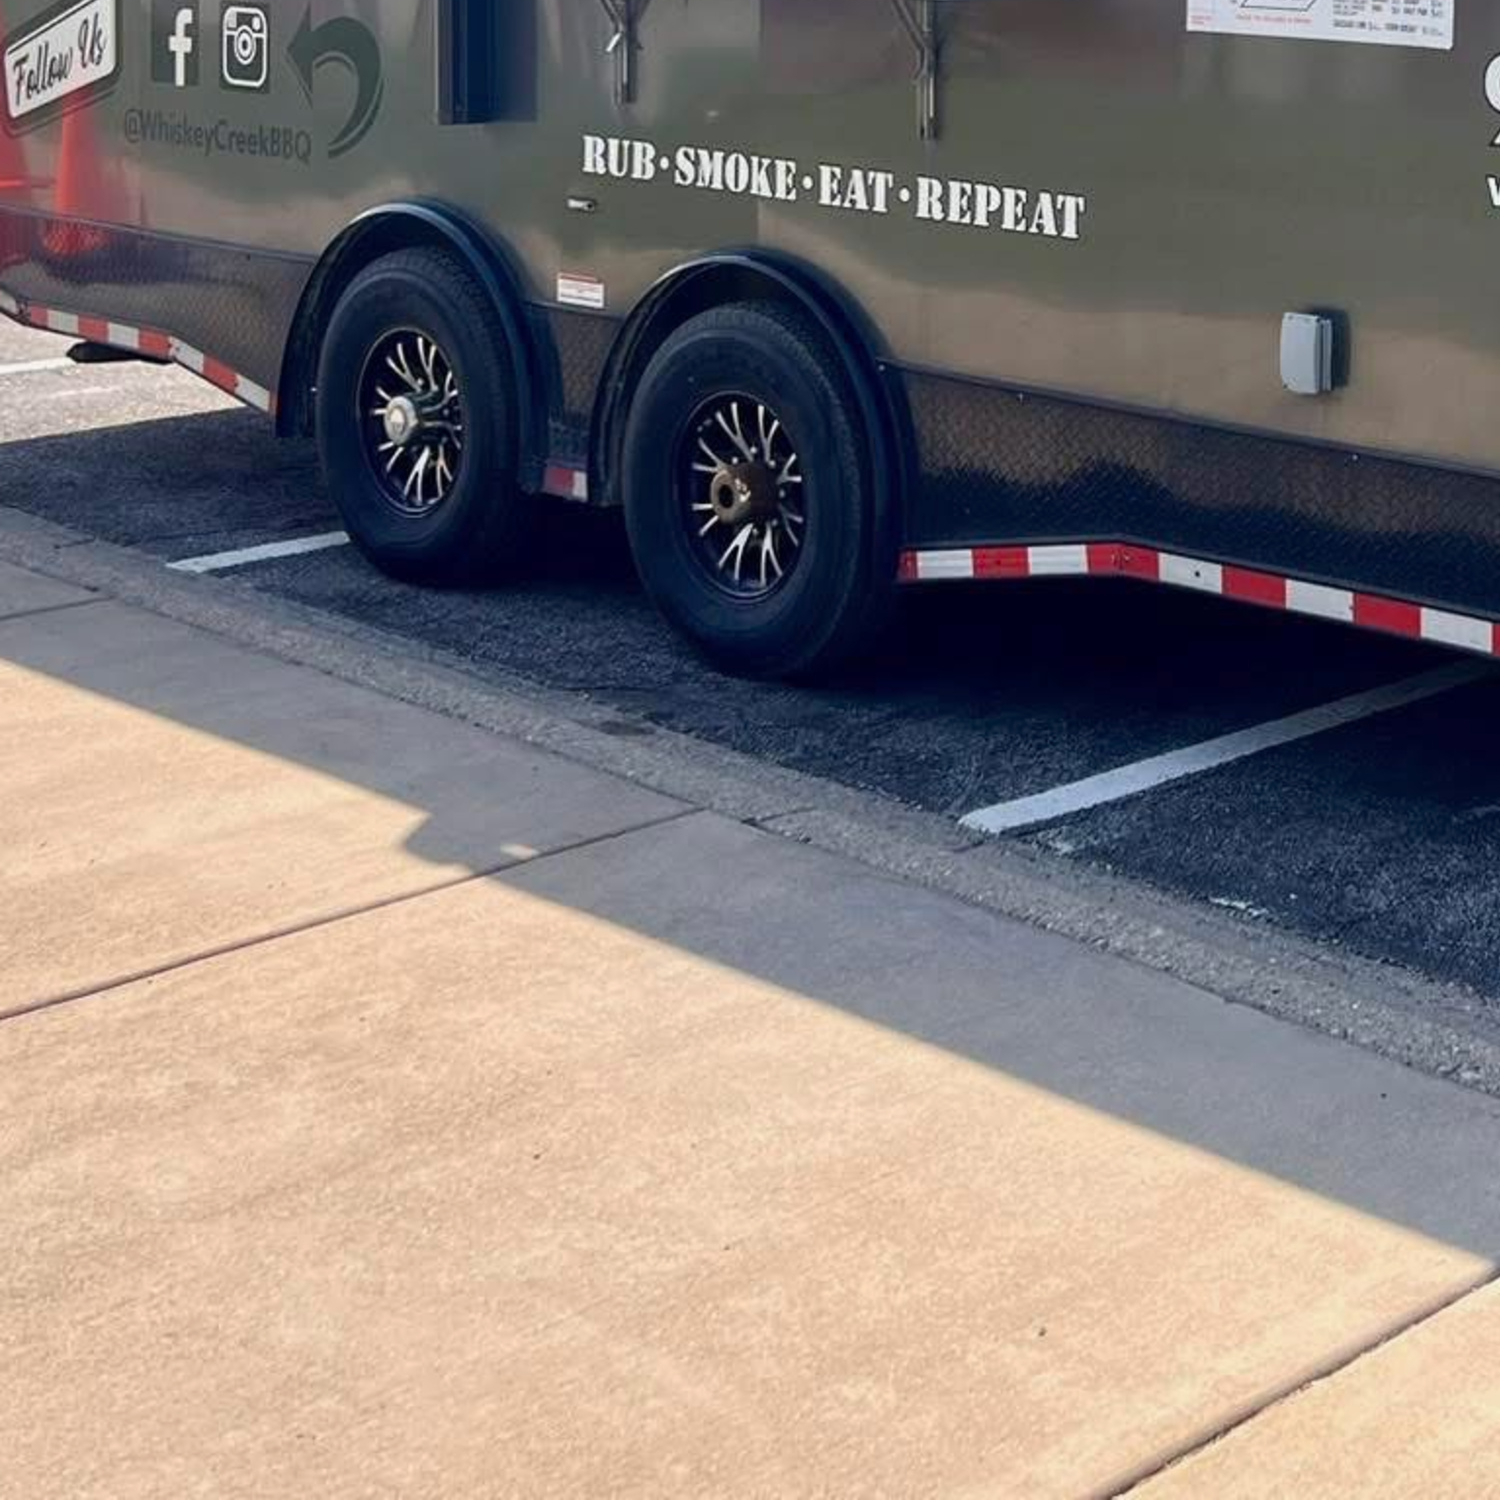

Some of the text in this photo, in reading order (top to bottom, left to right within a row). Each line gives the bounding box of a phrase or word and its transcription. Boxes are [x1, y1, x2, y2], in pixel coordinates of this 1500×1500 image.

[13, 12, 107, 106] Follow Us
[124, 108, 312, 165] @WhiskeyCreekBBQ
